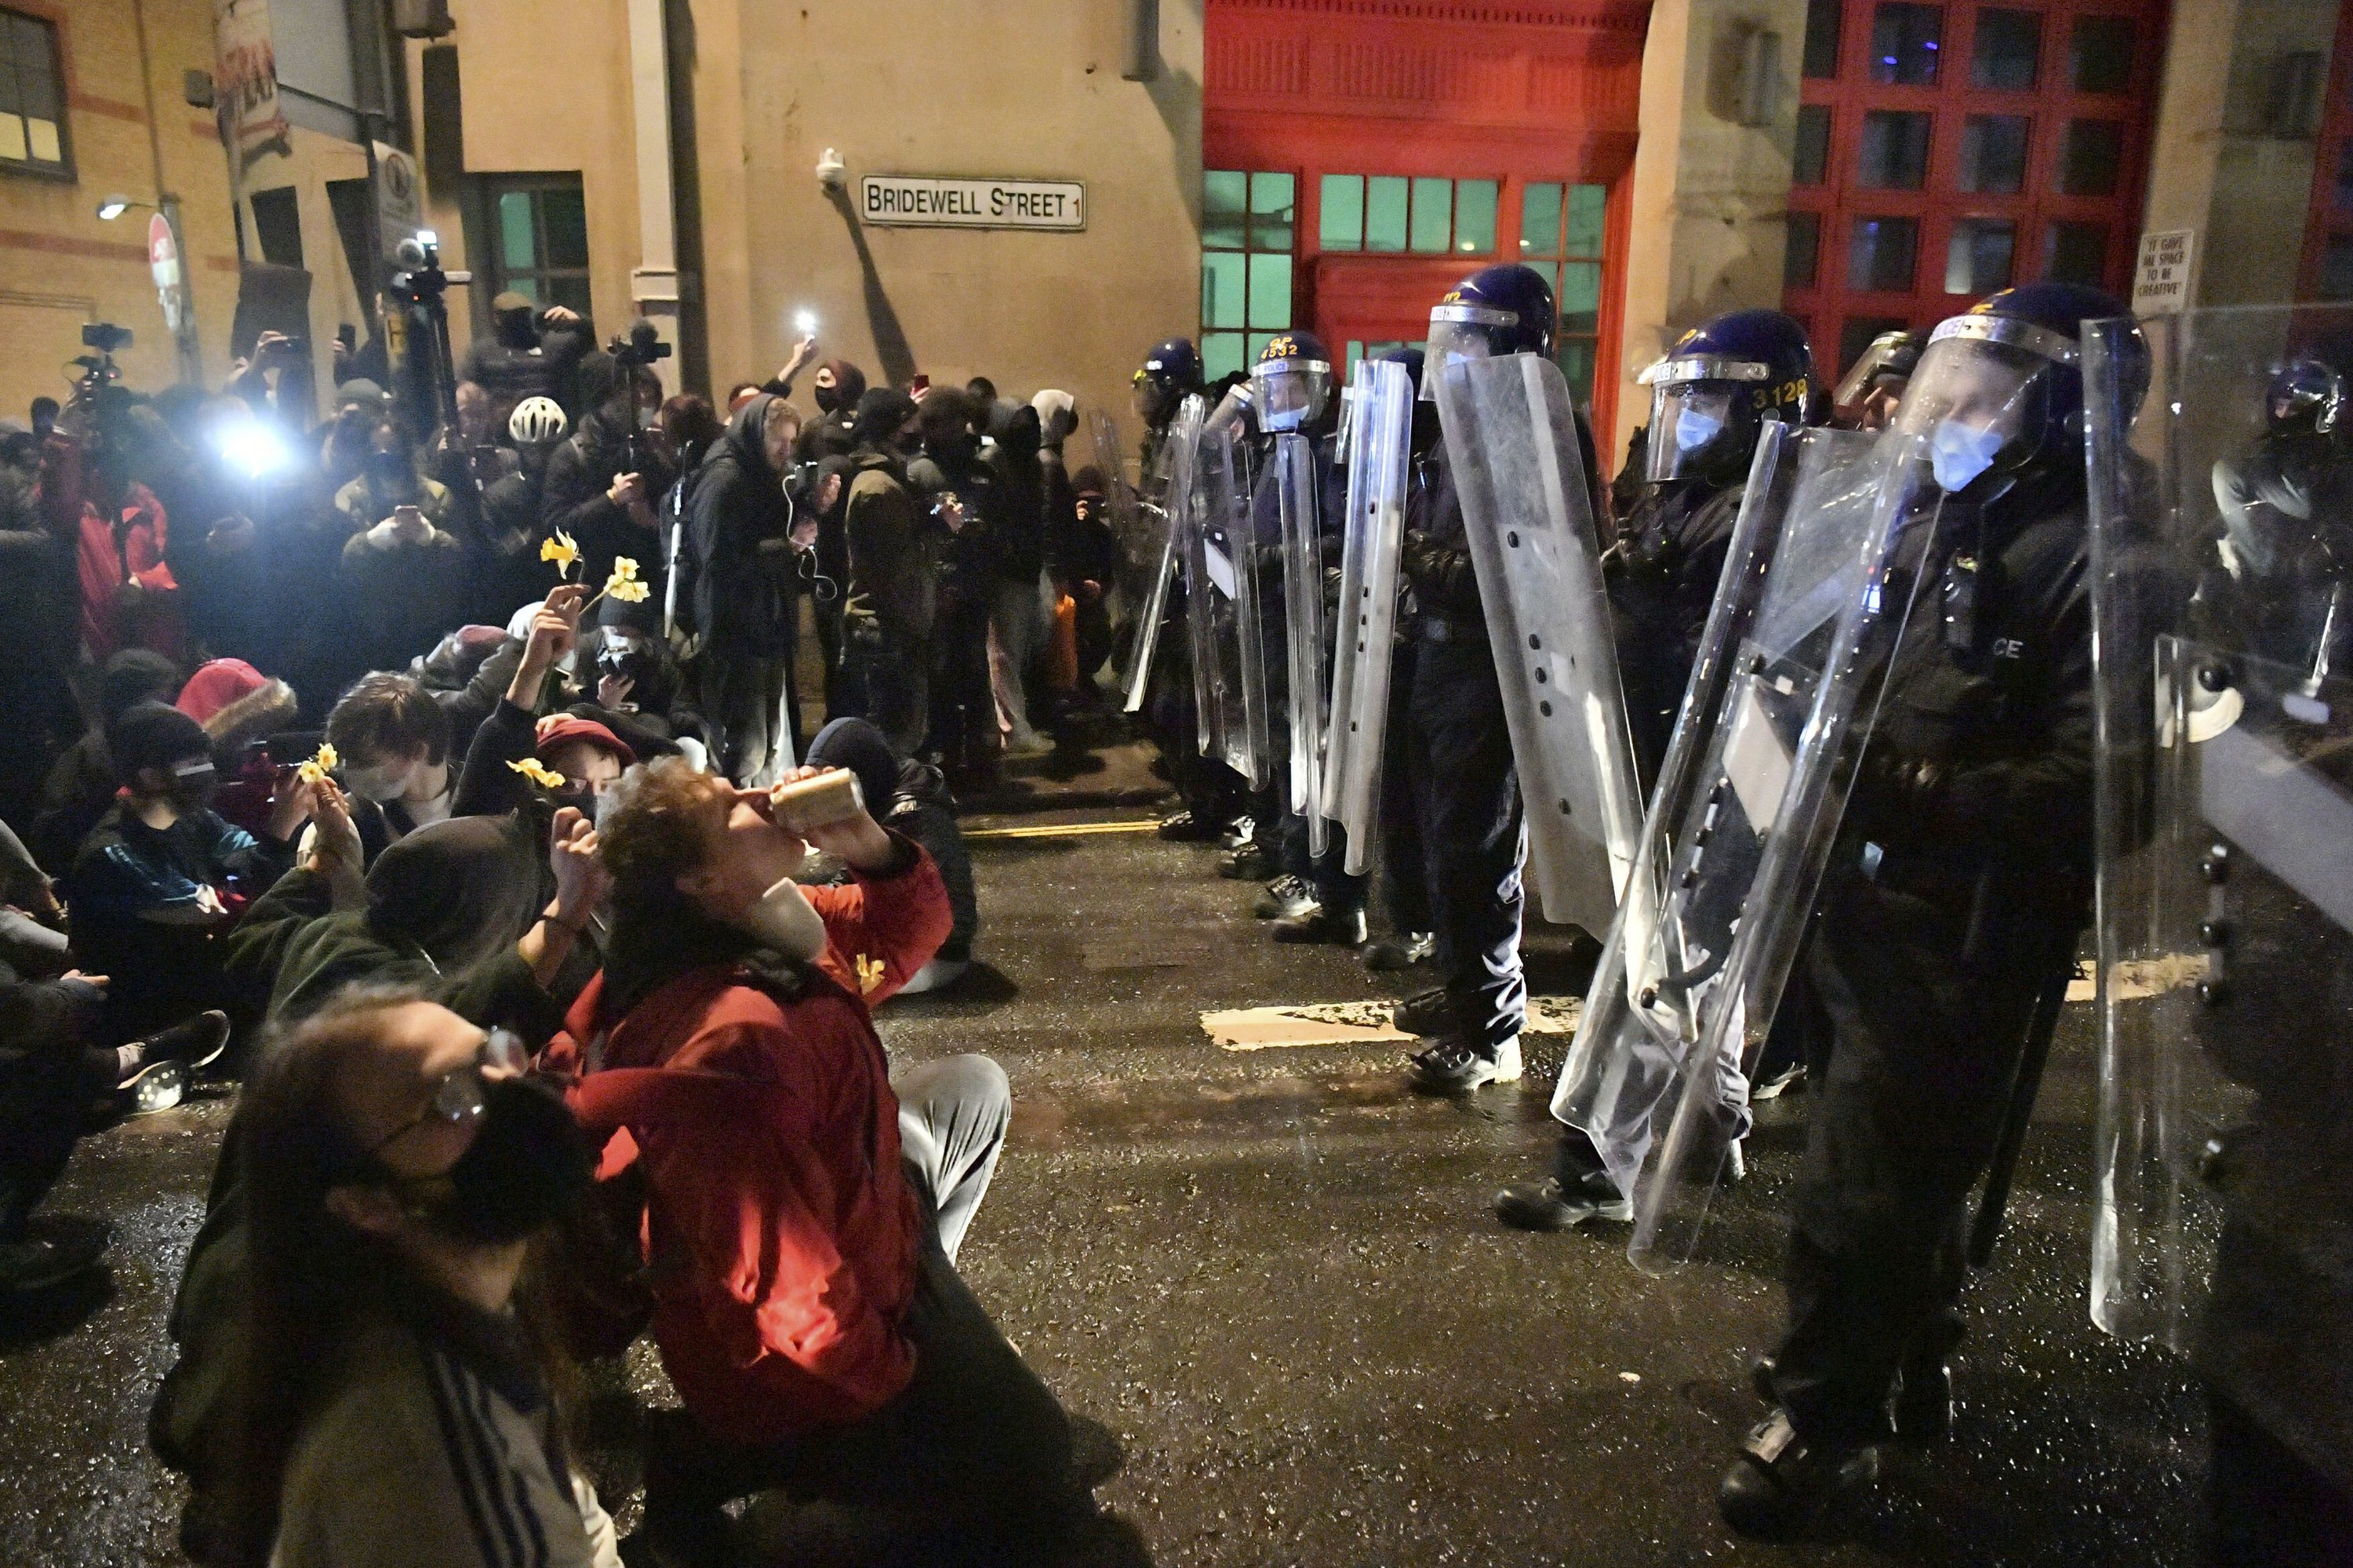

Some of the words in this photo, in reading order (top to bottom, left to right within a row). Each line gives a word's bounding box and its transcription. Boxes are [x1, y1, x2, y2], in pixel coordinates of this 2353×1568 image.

[867, 184, 982, 215] BRIDEWELL
[991, 187, 1066, 217] STREET
[1073, 198, 1081, 218] 1
[1260, 344, 1297, 359] 1532
